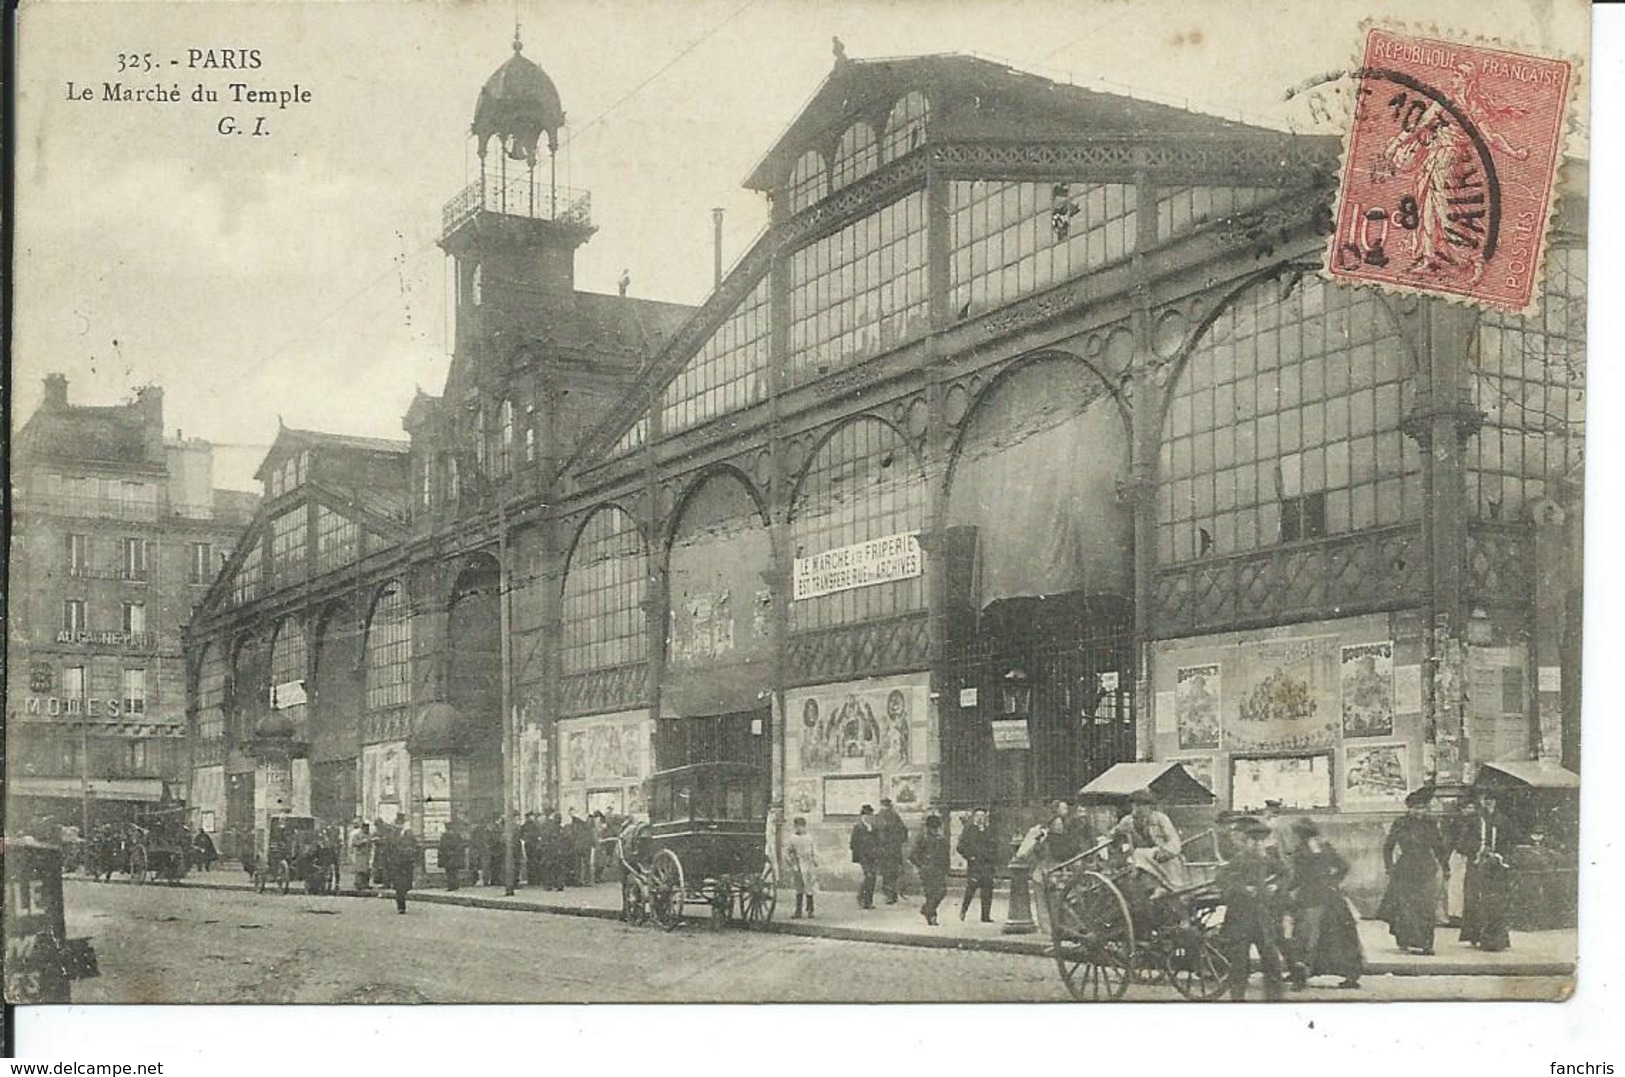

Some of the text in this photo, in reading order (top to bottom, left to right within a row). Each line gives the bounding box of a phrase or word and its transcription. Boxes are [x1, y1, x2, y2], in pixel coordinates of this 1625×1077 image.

[1505, 211, 1535, 289] POSTES
[800, 558, 810, 576] LE
[866, 535, 914, 560] FRIPERIE
[876, 555, 916, 579] ARCHIVES
[25, 697, 120, 717] MODES
